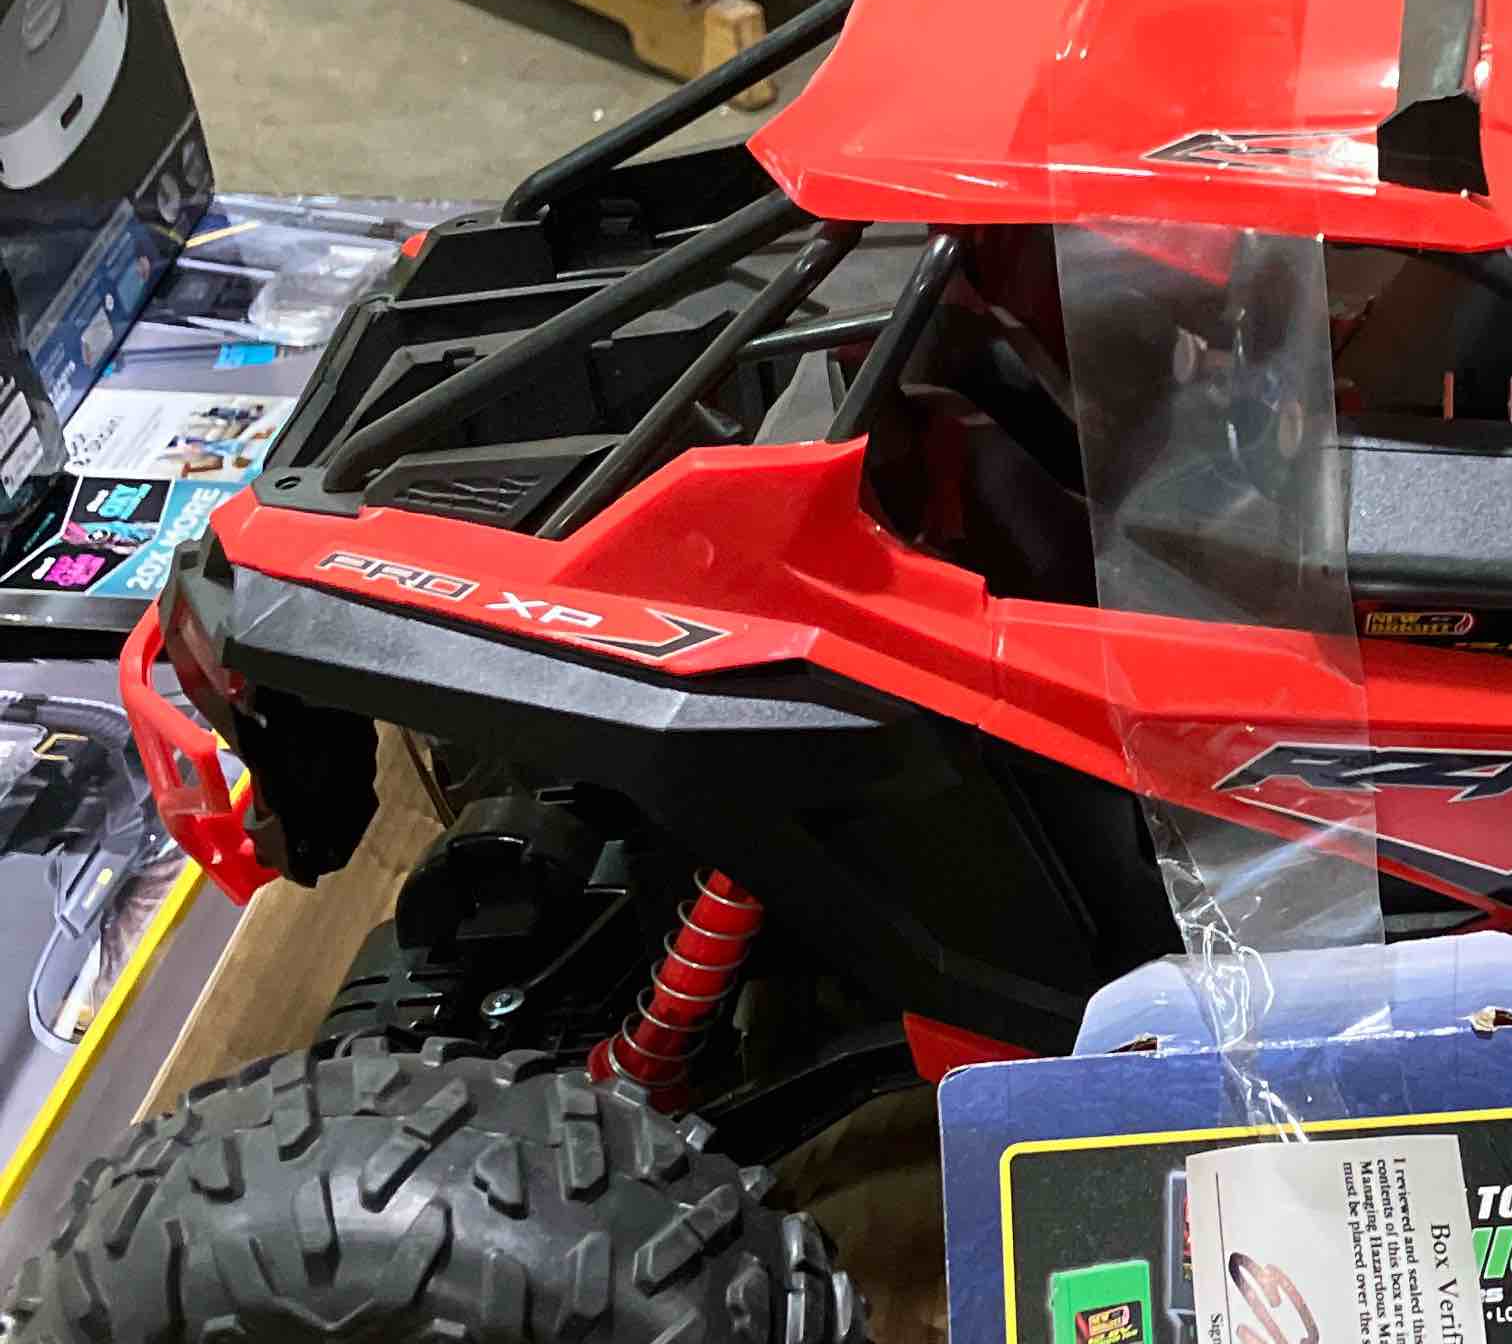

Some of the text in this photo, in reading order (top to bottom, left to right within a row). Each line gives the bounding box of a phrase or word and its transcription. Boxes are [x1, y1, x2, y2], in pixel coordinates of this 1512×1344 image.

[313, 551, 604, 629] PRO XP
[1343, 1162, 1357, 1197] must
[1377, 1159, 1393, 1219] contents
[1348, 1200, 1360, 1217] be
[1396, 1169, 1415, 1233] reviewed
[1348, 1221, 1367, 1268] placed
[1360, 1160, 1377, 1233] Managing
[1369, 1237, 1387, 1318] Hazardous
[1386, 1222, 1399, 1237] of
[1430, 1223, 1451, 1269] Box
[1388, 1241, 1400, 1268] this
[1405, 1236, 1419, 1264] and
[1356, 1273, 1367, 1307] over
[1391, 1273, 1403, 1299] box
[1408, 1268, 1424, 1314] sealed
[1360, 1311, 1372, 1335] the
[1394, 1304, 1404, 1328] are
